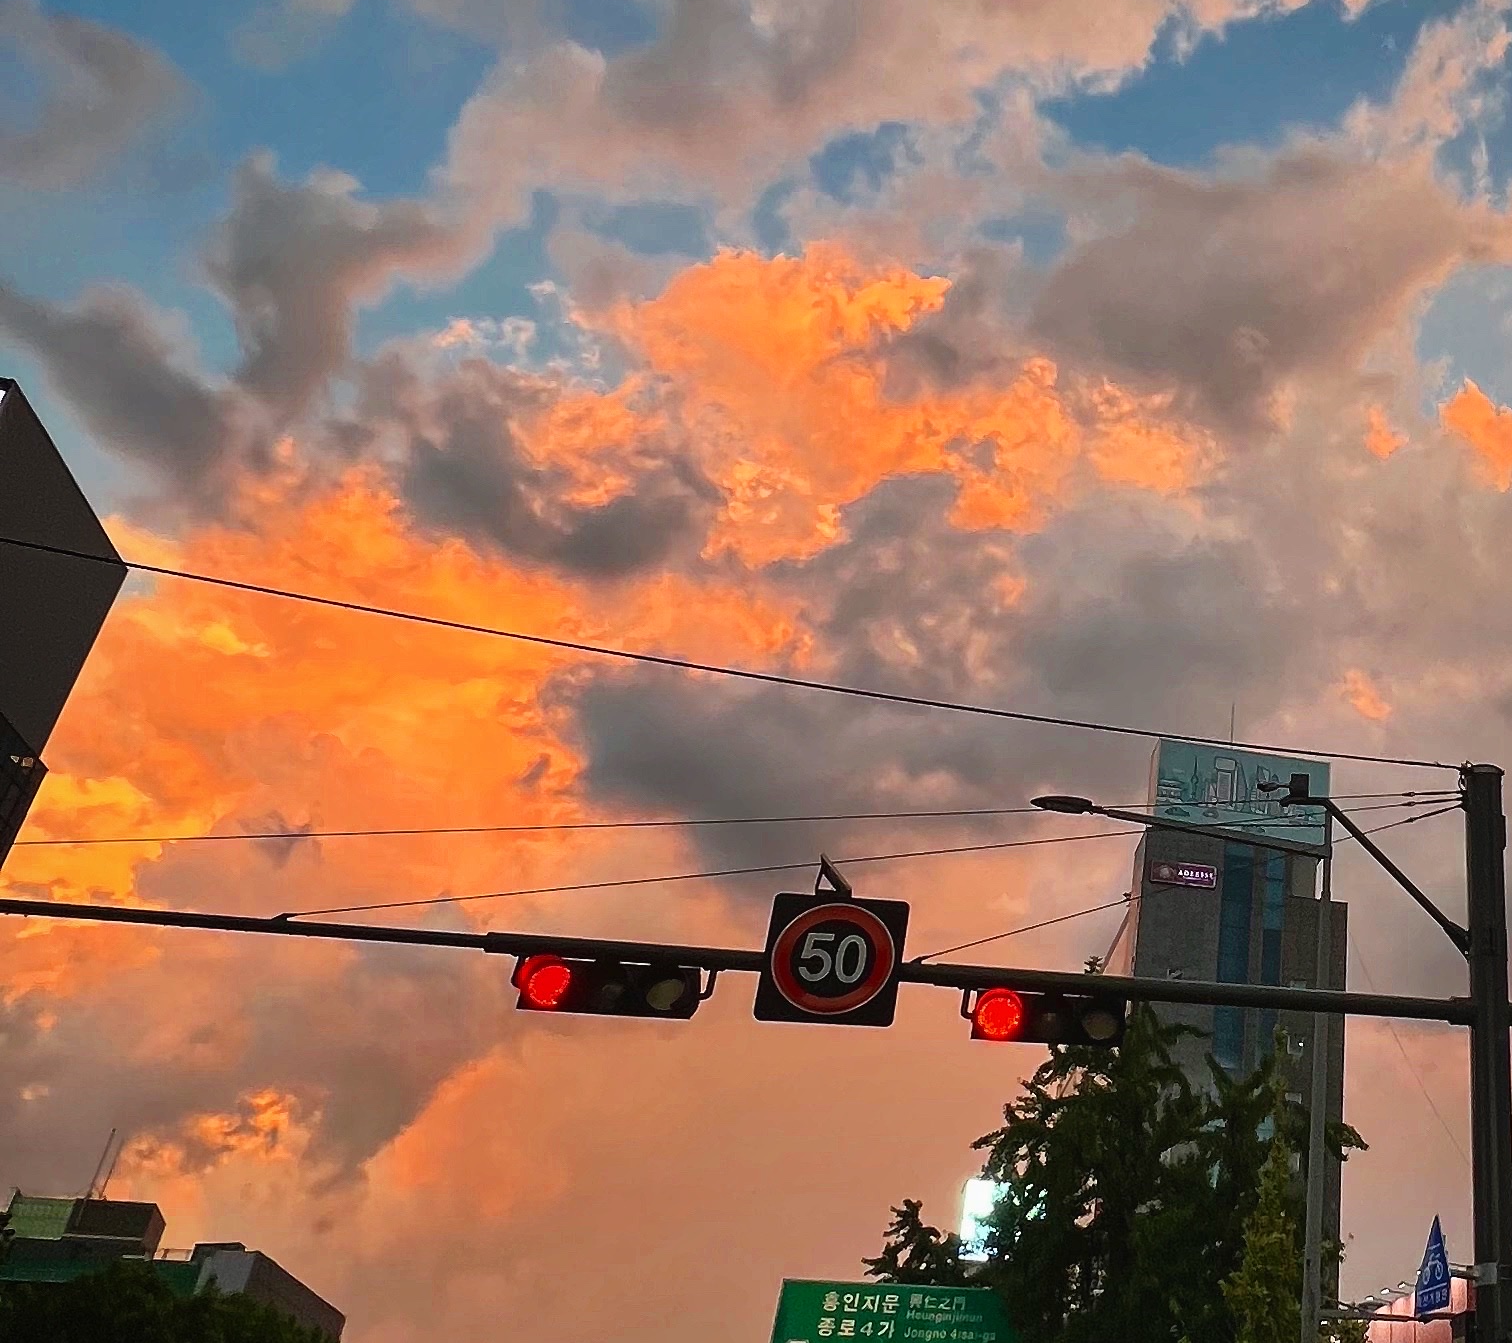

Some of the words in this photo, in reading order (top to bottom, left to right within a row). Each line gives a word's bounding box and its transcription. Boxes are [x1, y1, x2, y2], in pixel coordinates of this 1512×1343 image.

[798, 932, 867, 984] 50
[822, 1291, 900, 1313] 흥인지문
[904, 1327, 947, 1342] Jongno
